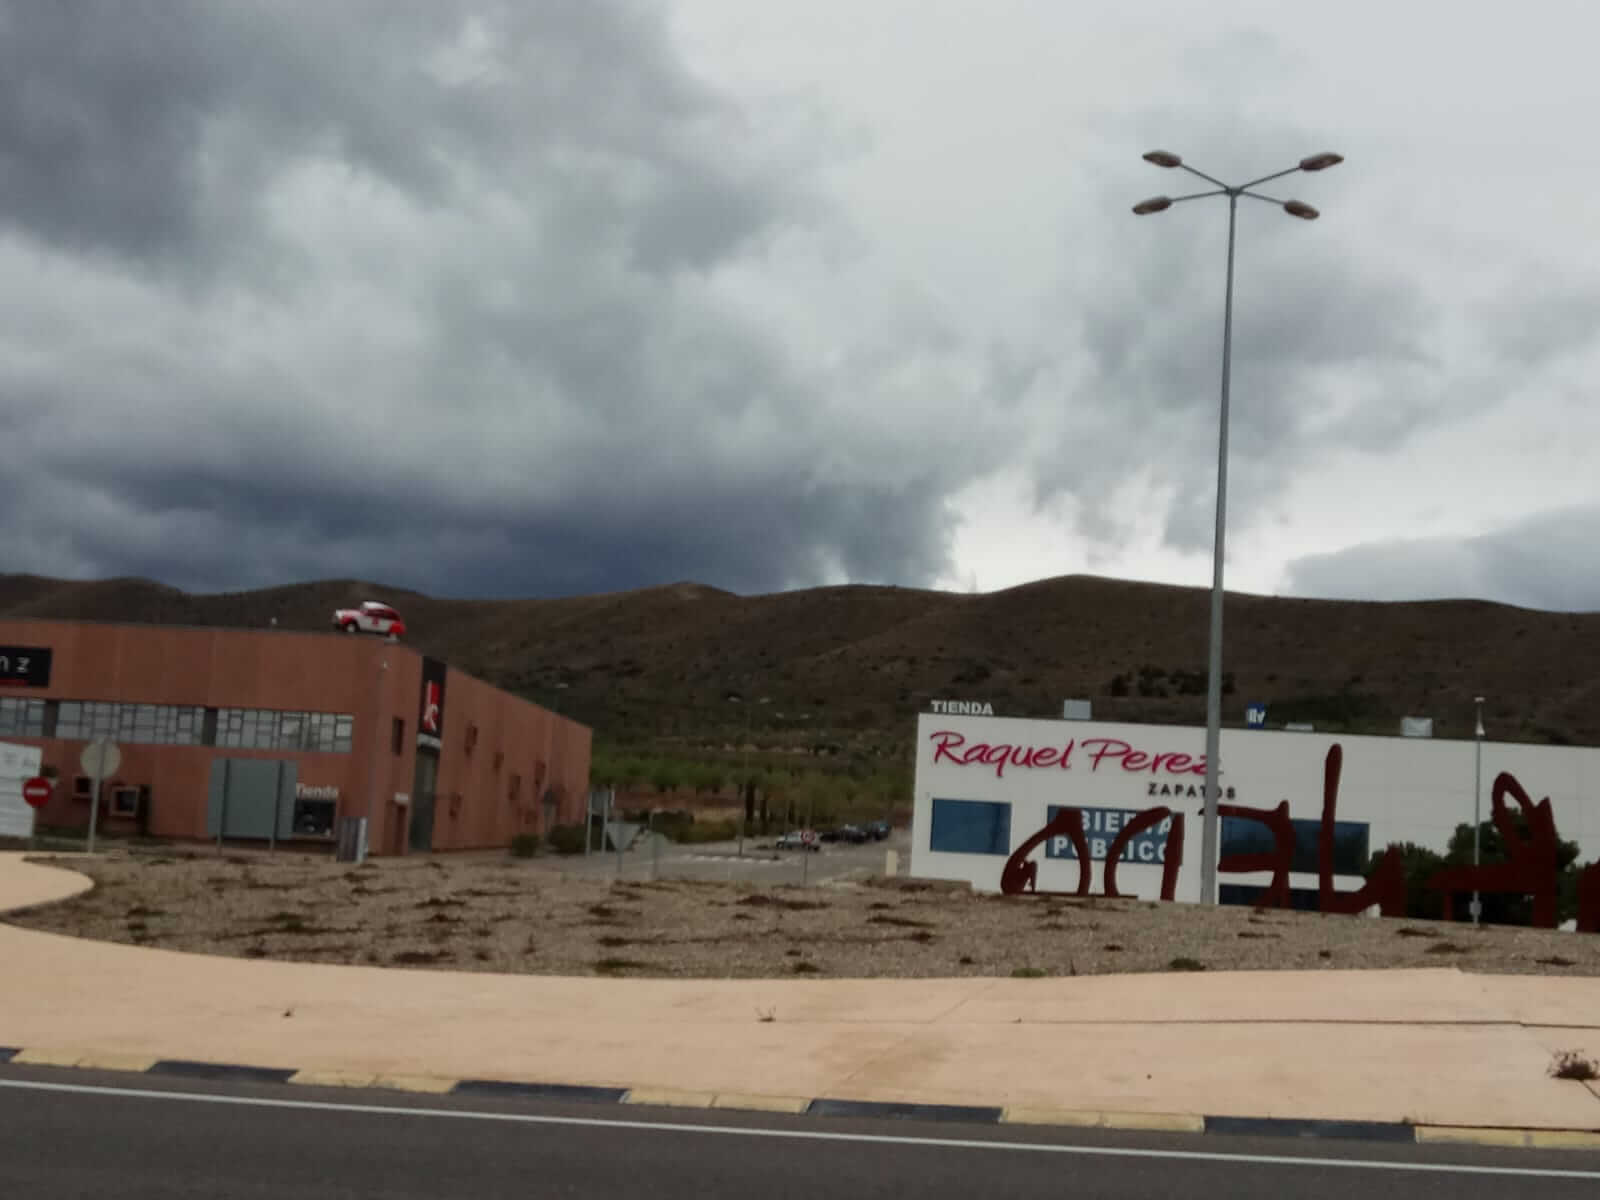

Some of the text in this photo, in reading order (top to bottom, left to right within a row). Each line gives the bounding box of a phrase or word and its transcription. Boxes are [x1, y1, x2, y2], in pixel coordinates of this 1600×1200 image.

[931, 699, 994, 716] TIENDA
[930, 731, 1075, 778] Raquel
[296, 783, 339, 799] Tienda
